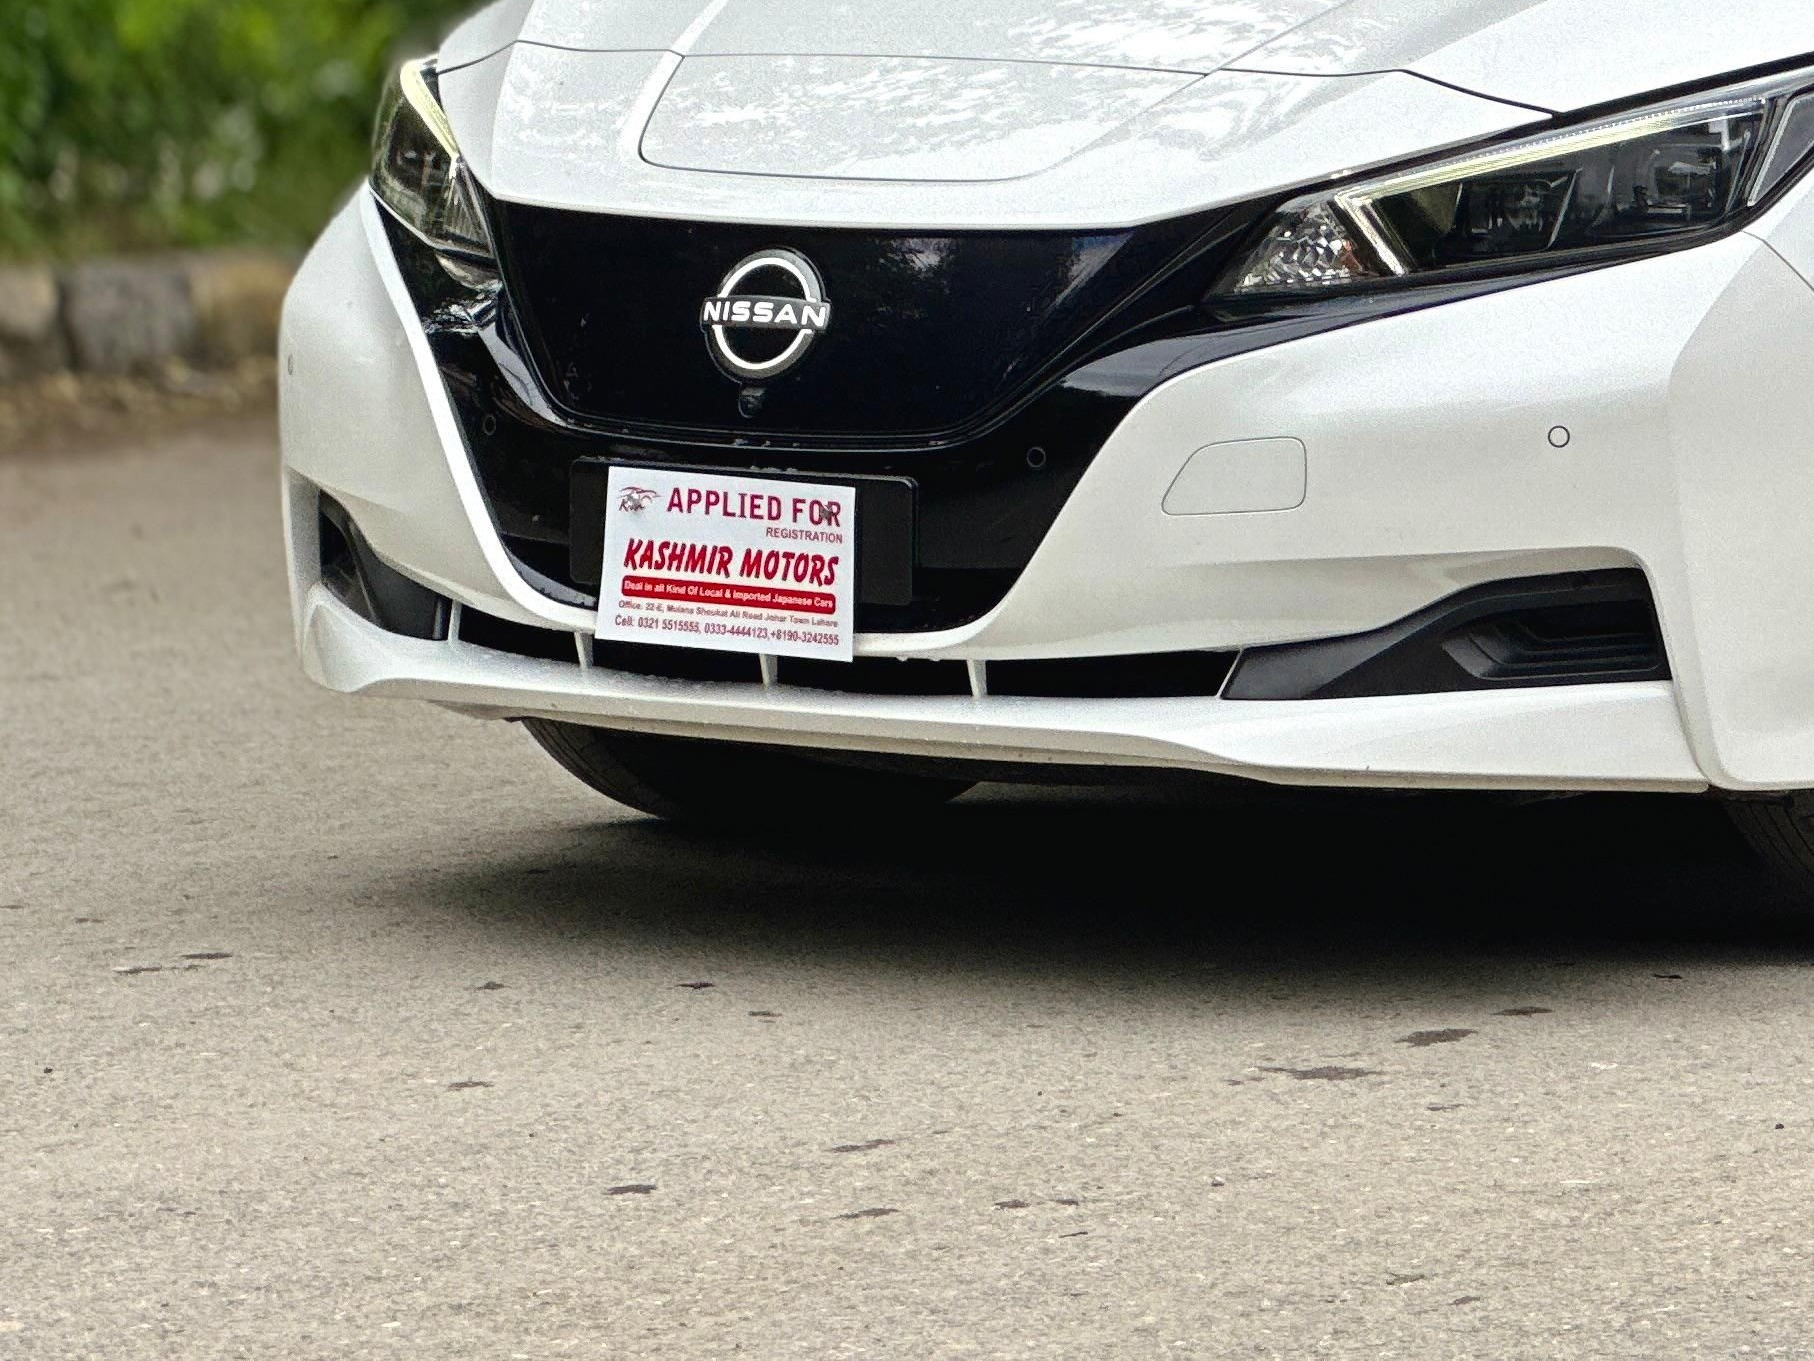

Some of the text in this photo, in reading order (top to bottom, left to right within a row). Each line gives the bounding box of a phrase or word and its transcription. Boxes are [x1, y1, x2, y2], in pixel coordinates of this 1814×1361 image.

[703, 300, 827, 327] NISSAN
[667, 487, 782, 521] APPLIED
[792, 498, 842, 527] FOR
[765, 526, 843, 544] REGISTRATION
[623, 537, 840, 587] KASHMIR MOTORS
[700, 586, 723, 598] Local
[725, 589, 732, 599] &
[814, 596, 834, 608] Cars
[638, 616, 659, 629] 0321
